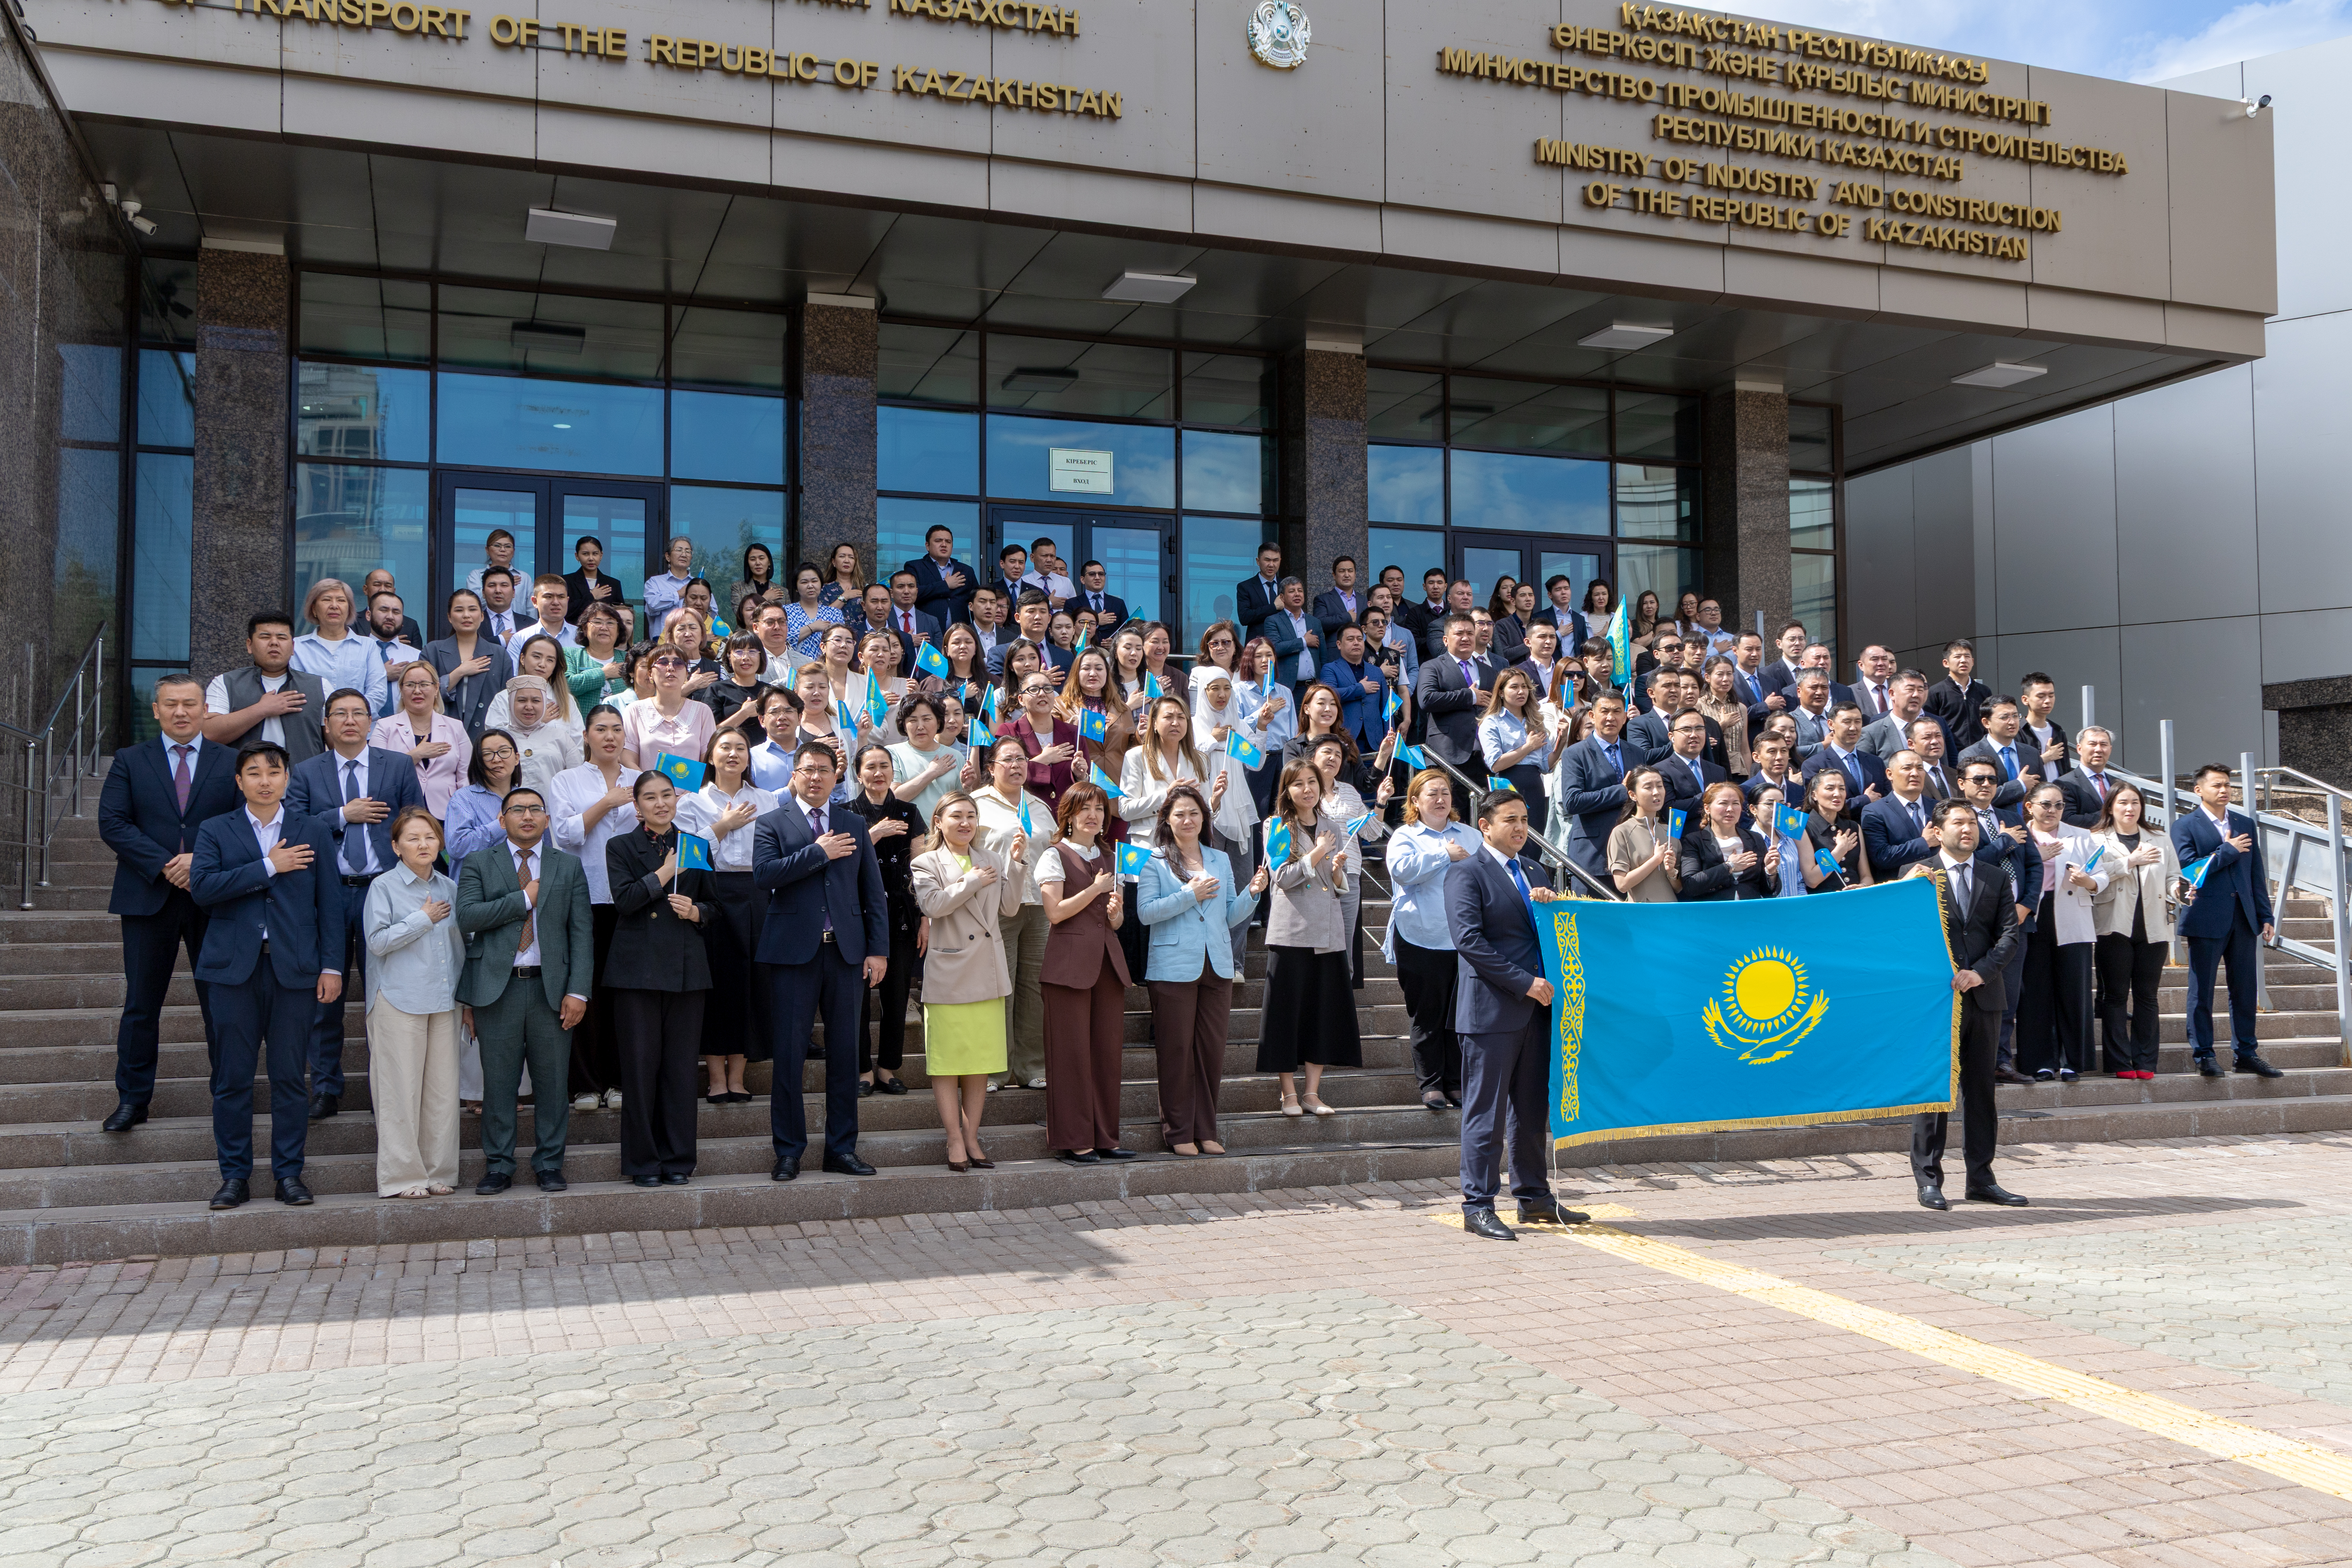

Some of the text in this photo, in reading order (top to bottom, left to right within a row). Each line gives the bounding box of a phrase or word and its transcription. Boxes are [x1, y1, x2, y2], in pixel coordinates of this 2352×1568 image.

[490, 14, 539, 49] OF
[557, 22, 627, 59] THE
[650, 34, 818, 80] REPUBLIC
[835, 58, 879, 89] OF
[894, 64, 1122, 119] KAZAKHSTAN
[1552, 23, 2051, 126] ӨНЕРКӘСІП ЖӘНЕ ҚҰРЫЛЫС МИНИСТРЛІГІ
[1622, 2, 1989, 85] ҚАЗАҚСТАН РЕСПУБЛИКАСЫ
[1441, 47, 2130, 175] МИНИСТЕРСТВО ПРОМЫШЛЕННОСТИ И СТРОИТЕЛЬСТВА
[1654, 114, 1964, 181] РЕСПУБЛИКИ КАЗАХСТАН
[1537, 138, 2062, 233] MINISTRY OF INDUSTRY AND CONSTRUCTION
[1584, 181, 2028, 261] OF THE REPUBLIC OF KAZAKHSTAN
